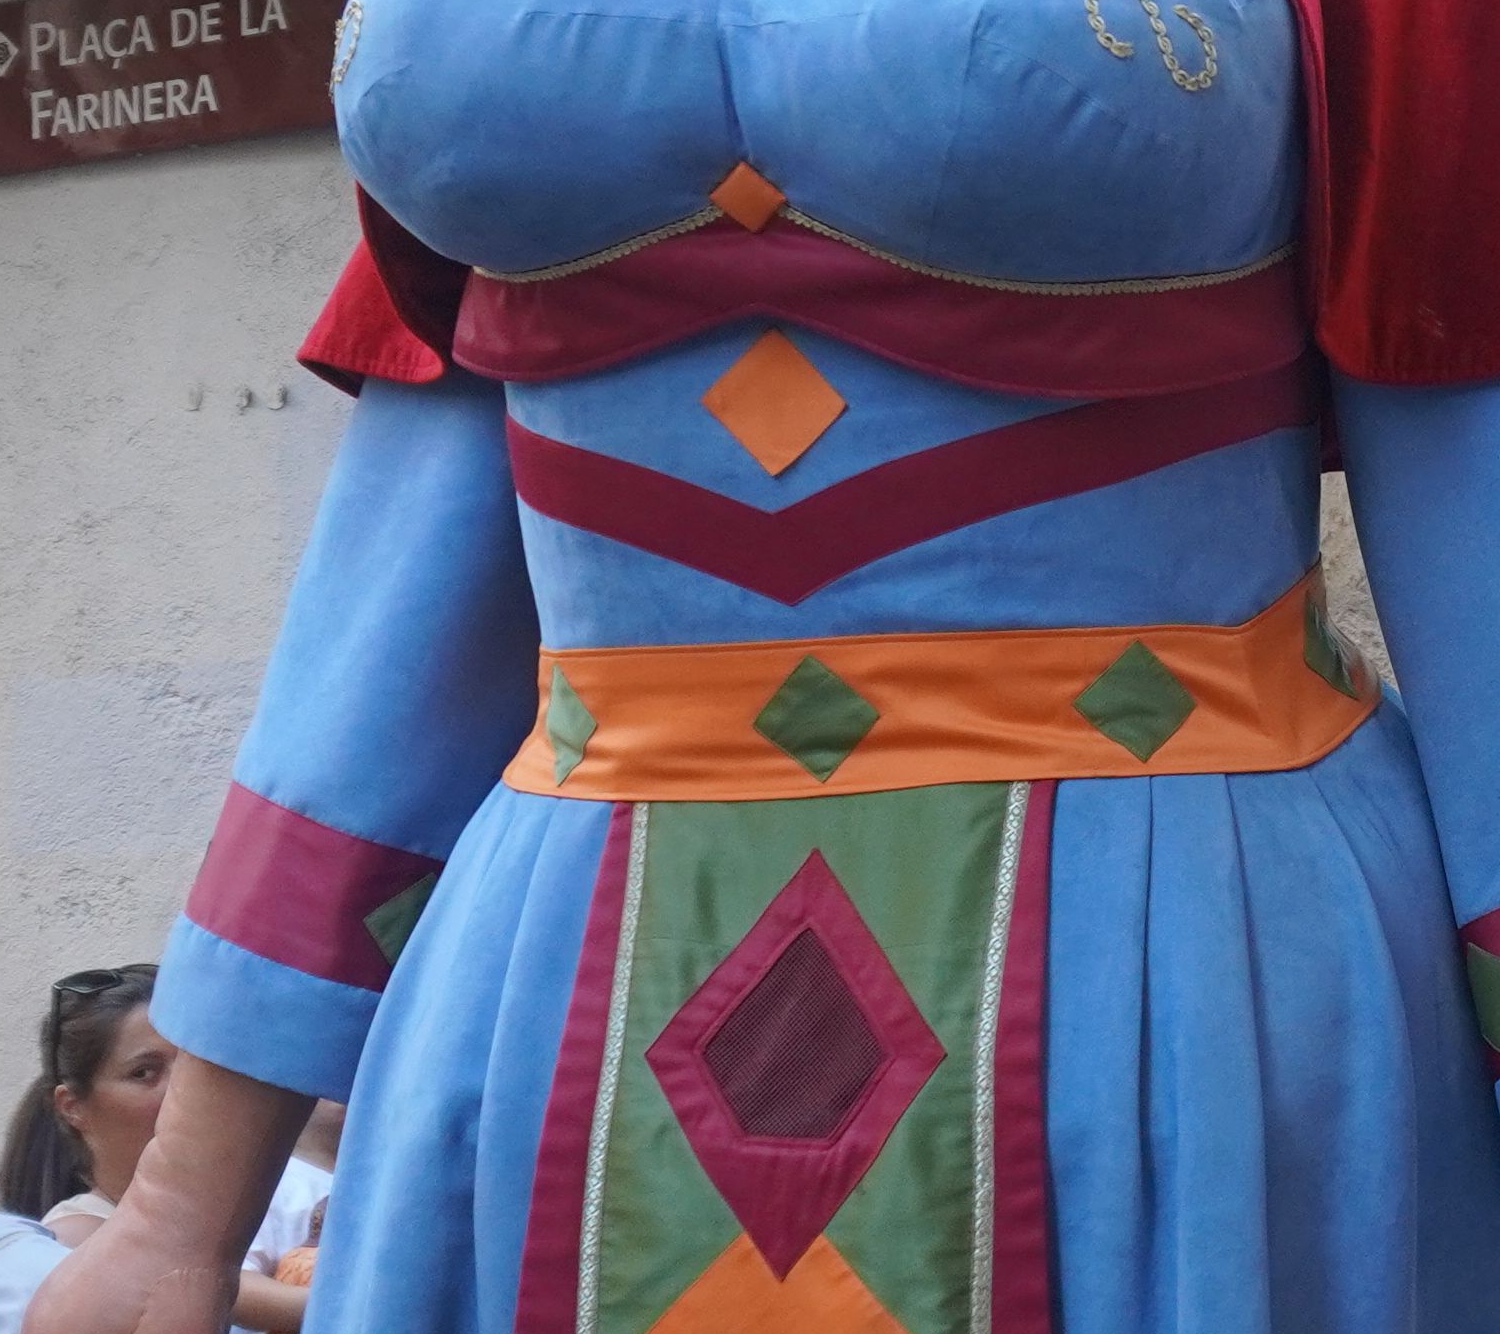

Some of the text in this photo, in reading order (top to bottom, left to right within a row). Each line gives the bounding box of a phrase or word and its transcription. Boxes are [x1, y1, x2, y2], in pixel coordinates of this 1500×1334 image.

[29, 14, 155, 70] PLAÇA
[170, 2, 223, 48] DE
[30, 74, 220, 140] FARINERA
